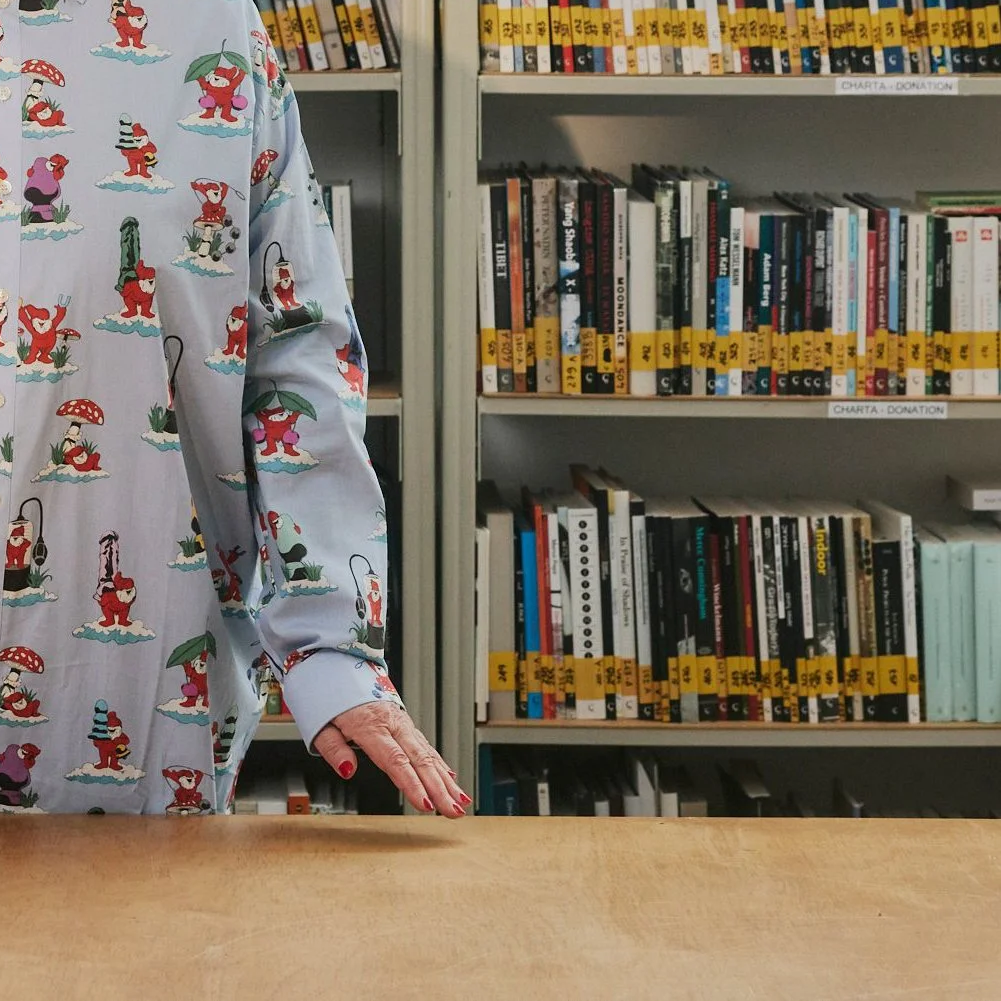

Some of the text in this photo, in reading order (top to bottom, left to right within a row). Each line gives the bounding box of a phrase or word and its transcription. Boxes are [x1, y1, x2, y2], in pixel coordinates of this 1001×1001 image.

[841, 81, 953, 90] CHARTA DONATION
[562, 201, 575, 227] Yang
[495, 240, 507, 279] TIBET
[719, 237, 728, 276] Alex Katz
[761, 253, 771, 307] Adam Berg
[616, 276, 625, 348] MOONDANCE
[833, 405, 944, 415] CHARTA DONATION
[815, 528, 828, 576] Indoor
[713, 583, 723, 642] Winckelmann
